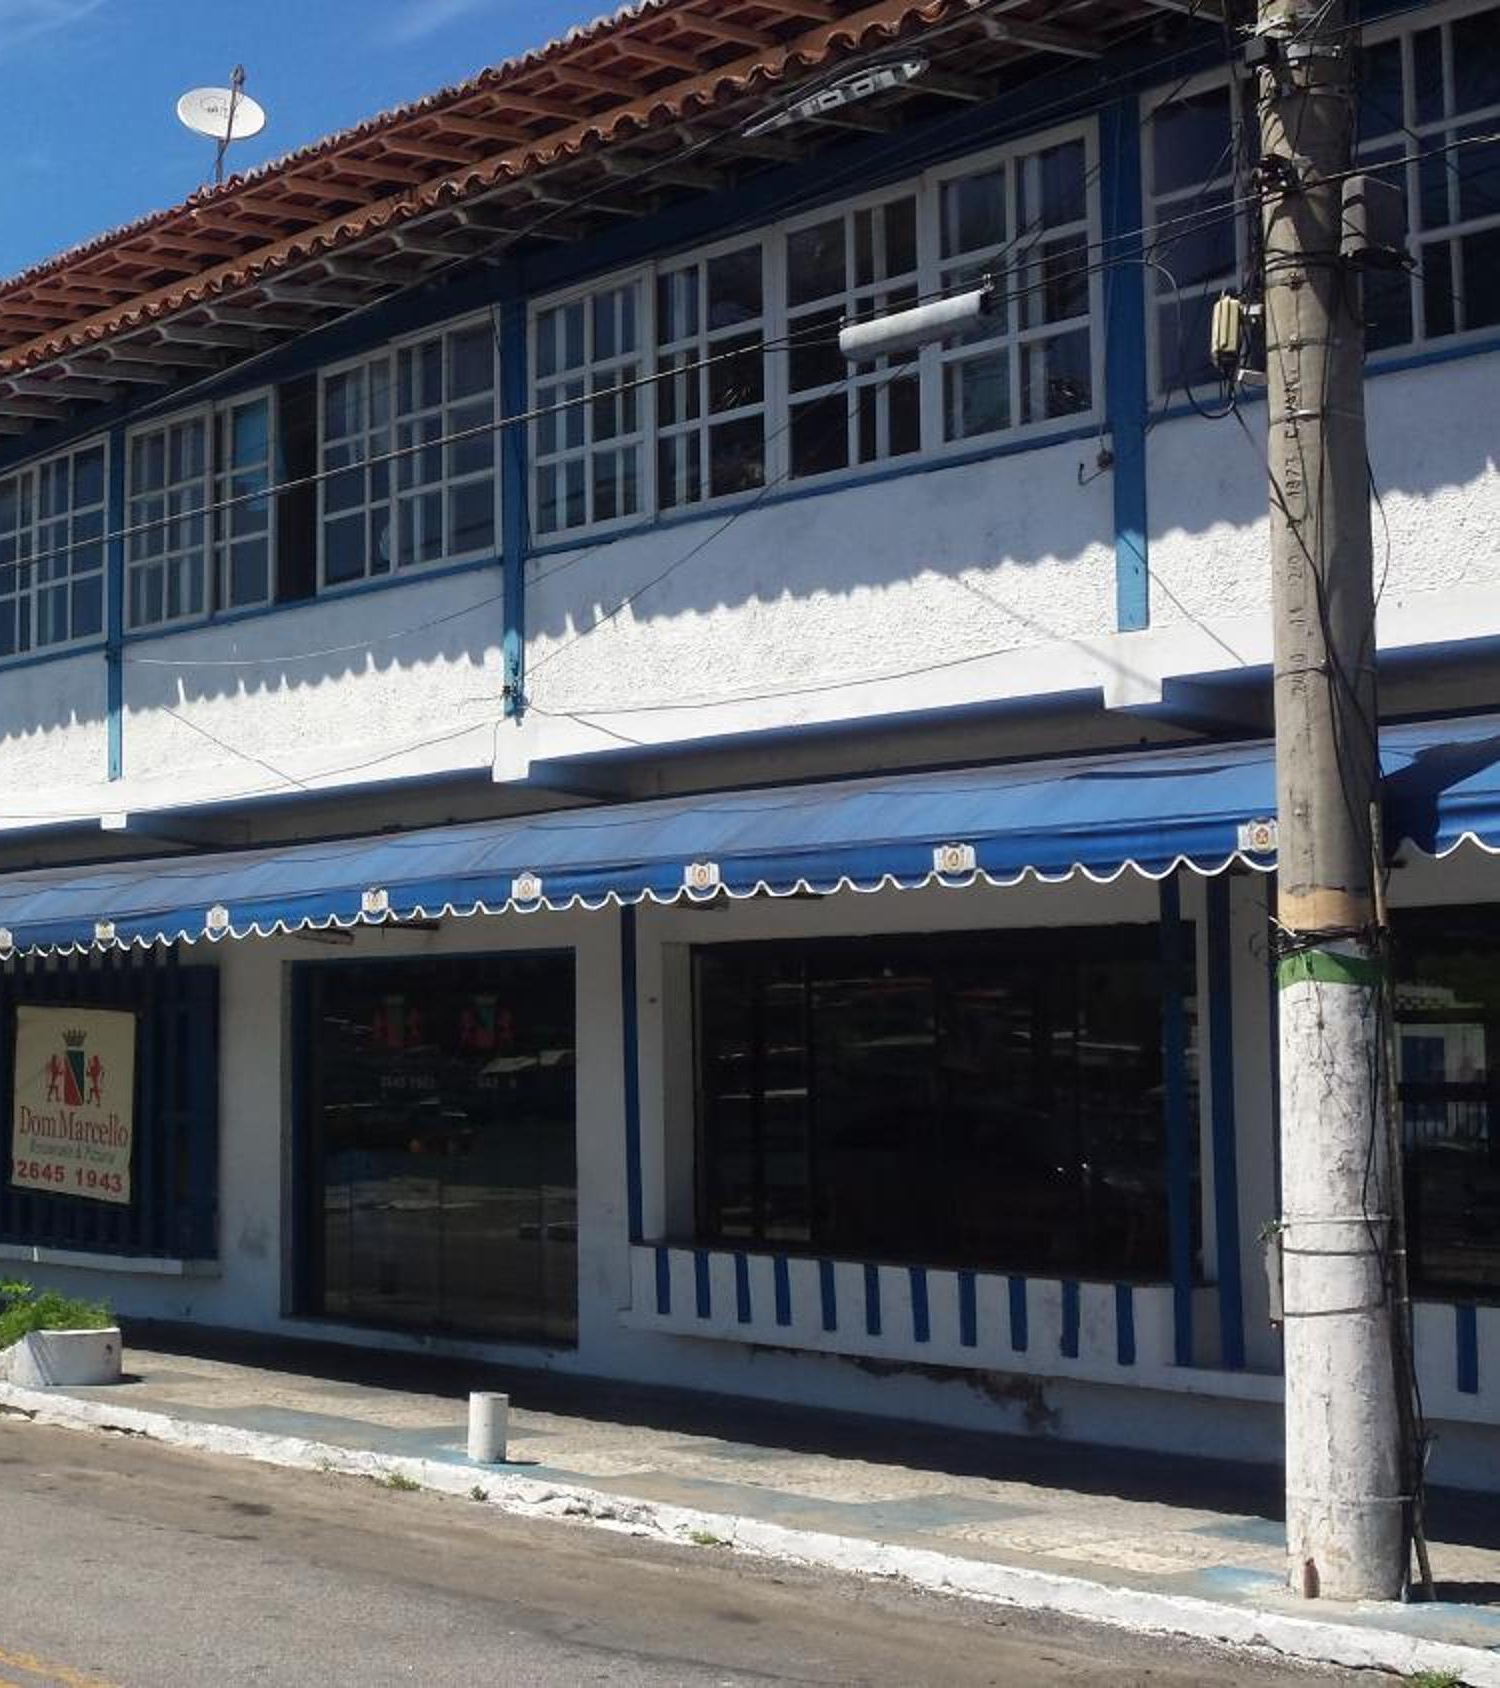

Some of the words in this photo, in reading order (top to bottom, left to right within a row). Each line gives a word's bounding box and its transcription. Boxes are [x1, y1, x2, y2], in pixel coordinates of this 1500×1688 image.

[19, 1105, 56, 1138] Dom
[57, 1110, 128, 1148] Marcello
[17, 1160, 66, 1183] 2645
[74, 1167, 123, 1193] 1943
